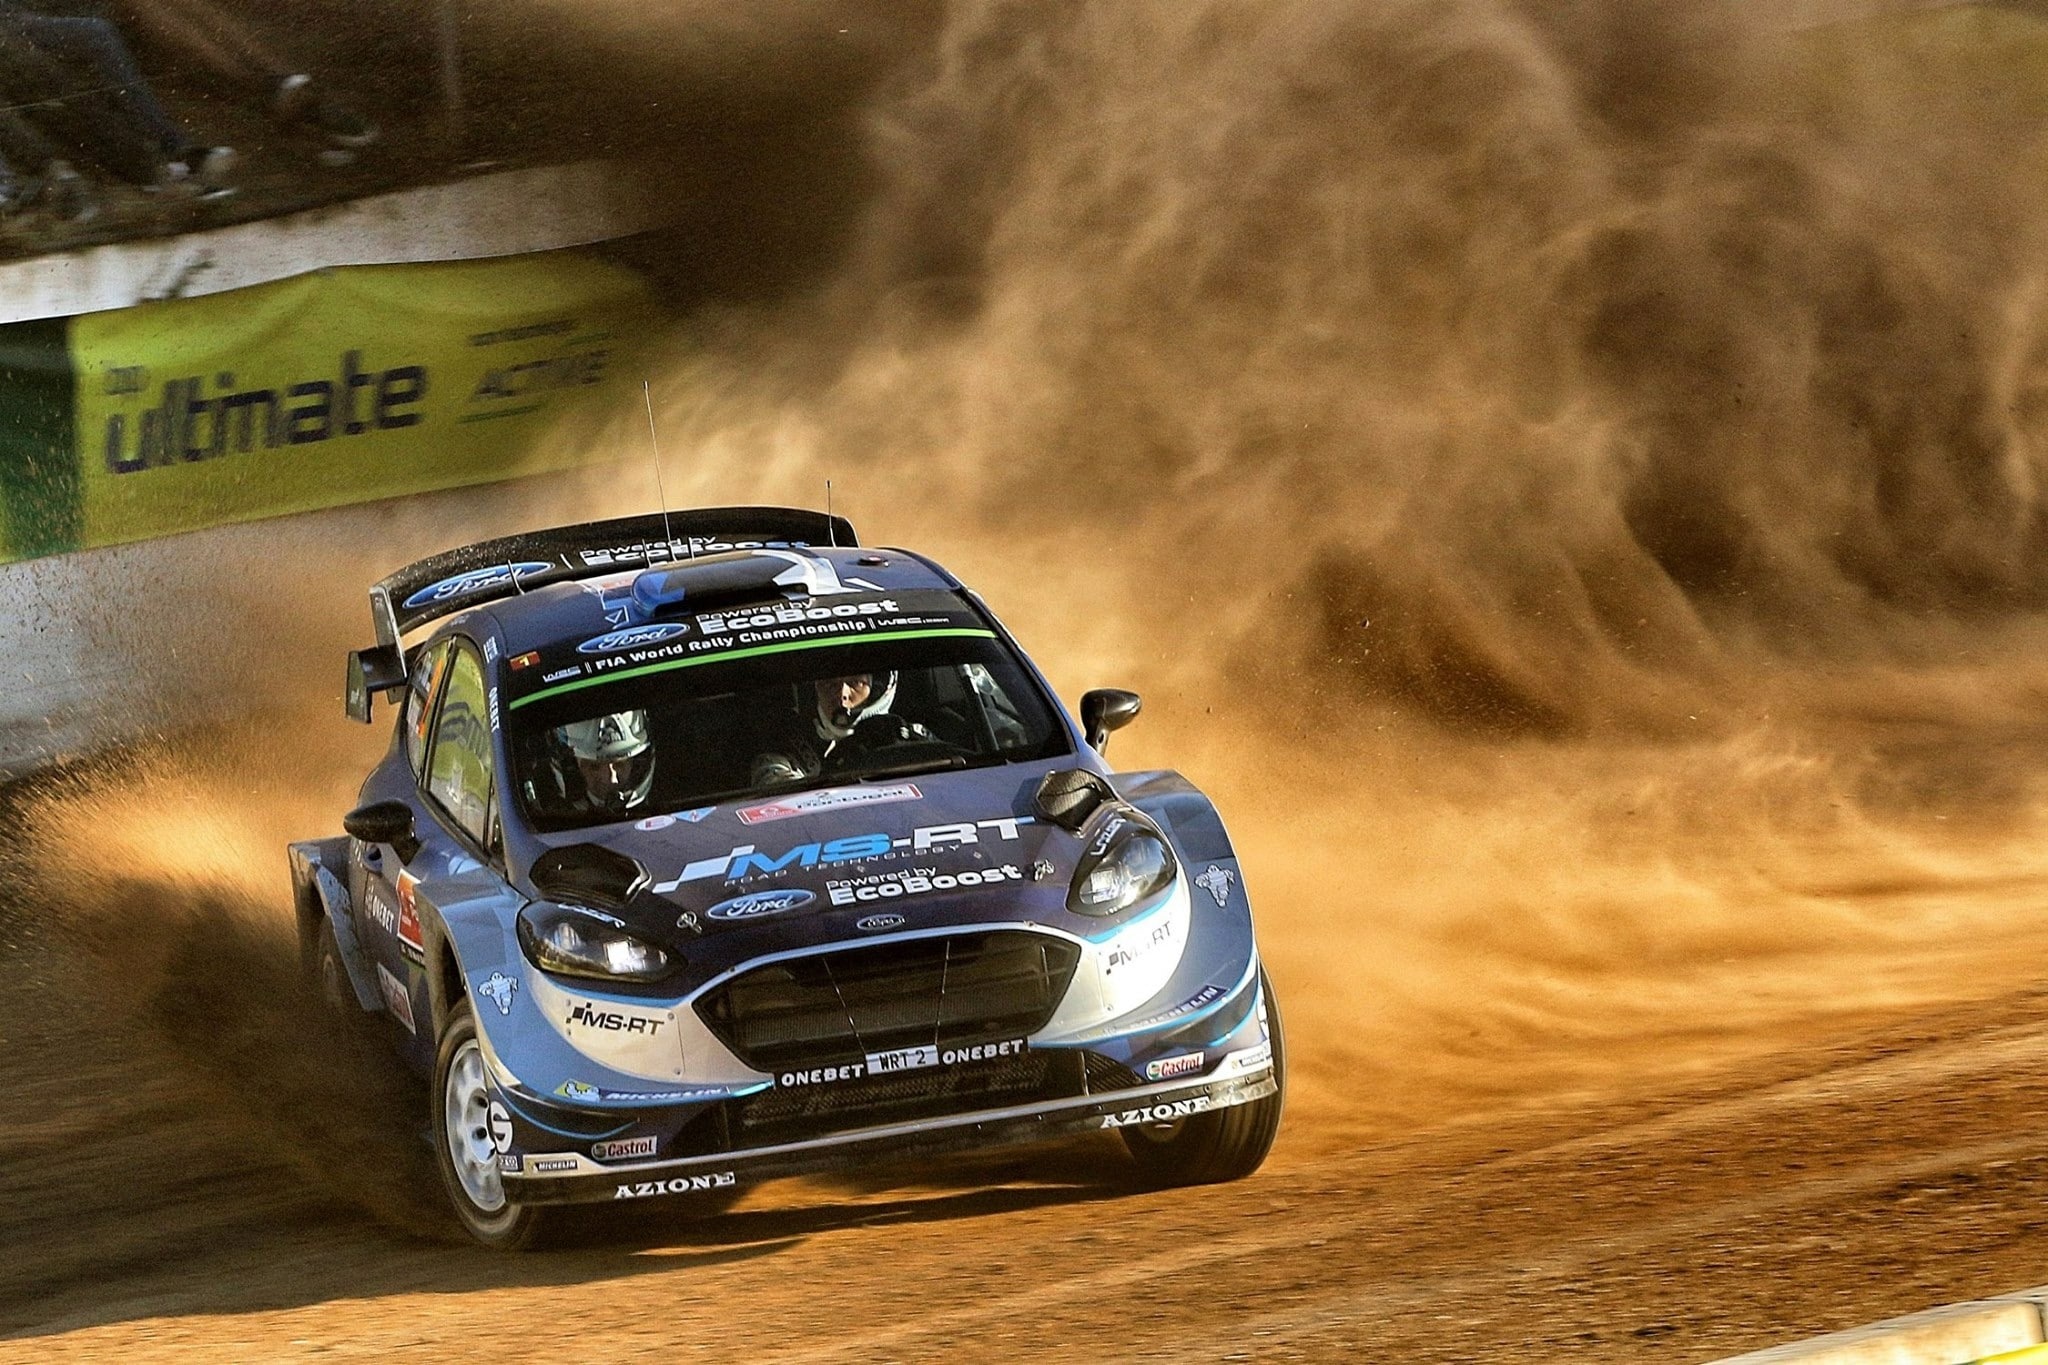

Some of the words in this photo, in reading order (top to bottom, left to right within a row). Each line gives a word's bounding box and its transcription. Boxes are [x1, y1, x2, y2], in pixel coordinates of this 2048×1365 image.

[105, 350, 427, 474] ultimate
[579, 538, 682, 557] Powered
[688, 536, 717, 548] by
[433, 567, 526, 599] Ford
[695, 598, 791, 621] Powered
[792, 597, 817, 611] by
[699, 599, 900, 636] EcoBoost
[596, 656, 626, 671] FIA
[629, 644, 683, 663] World
[688, 635, 735, 652] Rally
[739, 620, 867, 644] Championship
[597, 627, 669, 651] Ford
[727, 815, 1036, 881] MS-RT
[723, 869, 788, 888] ROAD
[802, 843, 960, 873] TECHNOLOGY
[825, 868, 910, 890] Powered
[912, 863, 938, 881] by
[830, 862, 1023, 907] EcoBoost
[726, 893, 795, 917] Ford
[581, 1010, 665, 1036] MS-RT
[878, 1053, 911, 1072] WRT
[915, 1050, 926, 1065] 2
[942, 1038, 1024, 1065] ONEBET
[780, 1063, 864, 1088] ONEBET
[1161, 1056, 1200, 1077] Castrol
[1100, 1095, 1212, 1129] AZIONE
[606, 1138, 655, 1159] Castrol
[537, 1159, 578, 1171] MICHELIN
[613, 1171, 736, 1200] AZIONE
